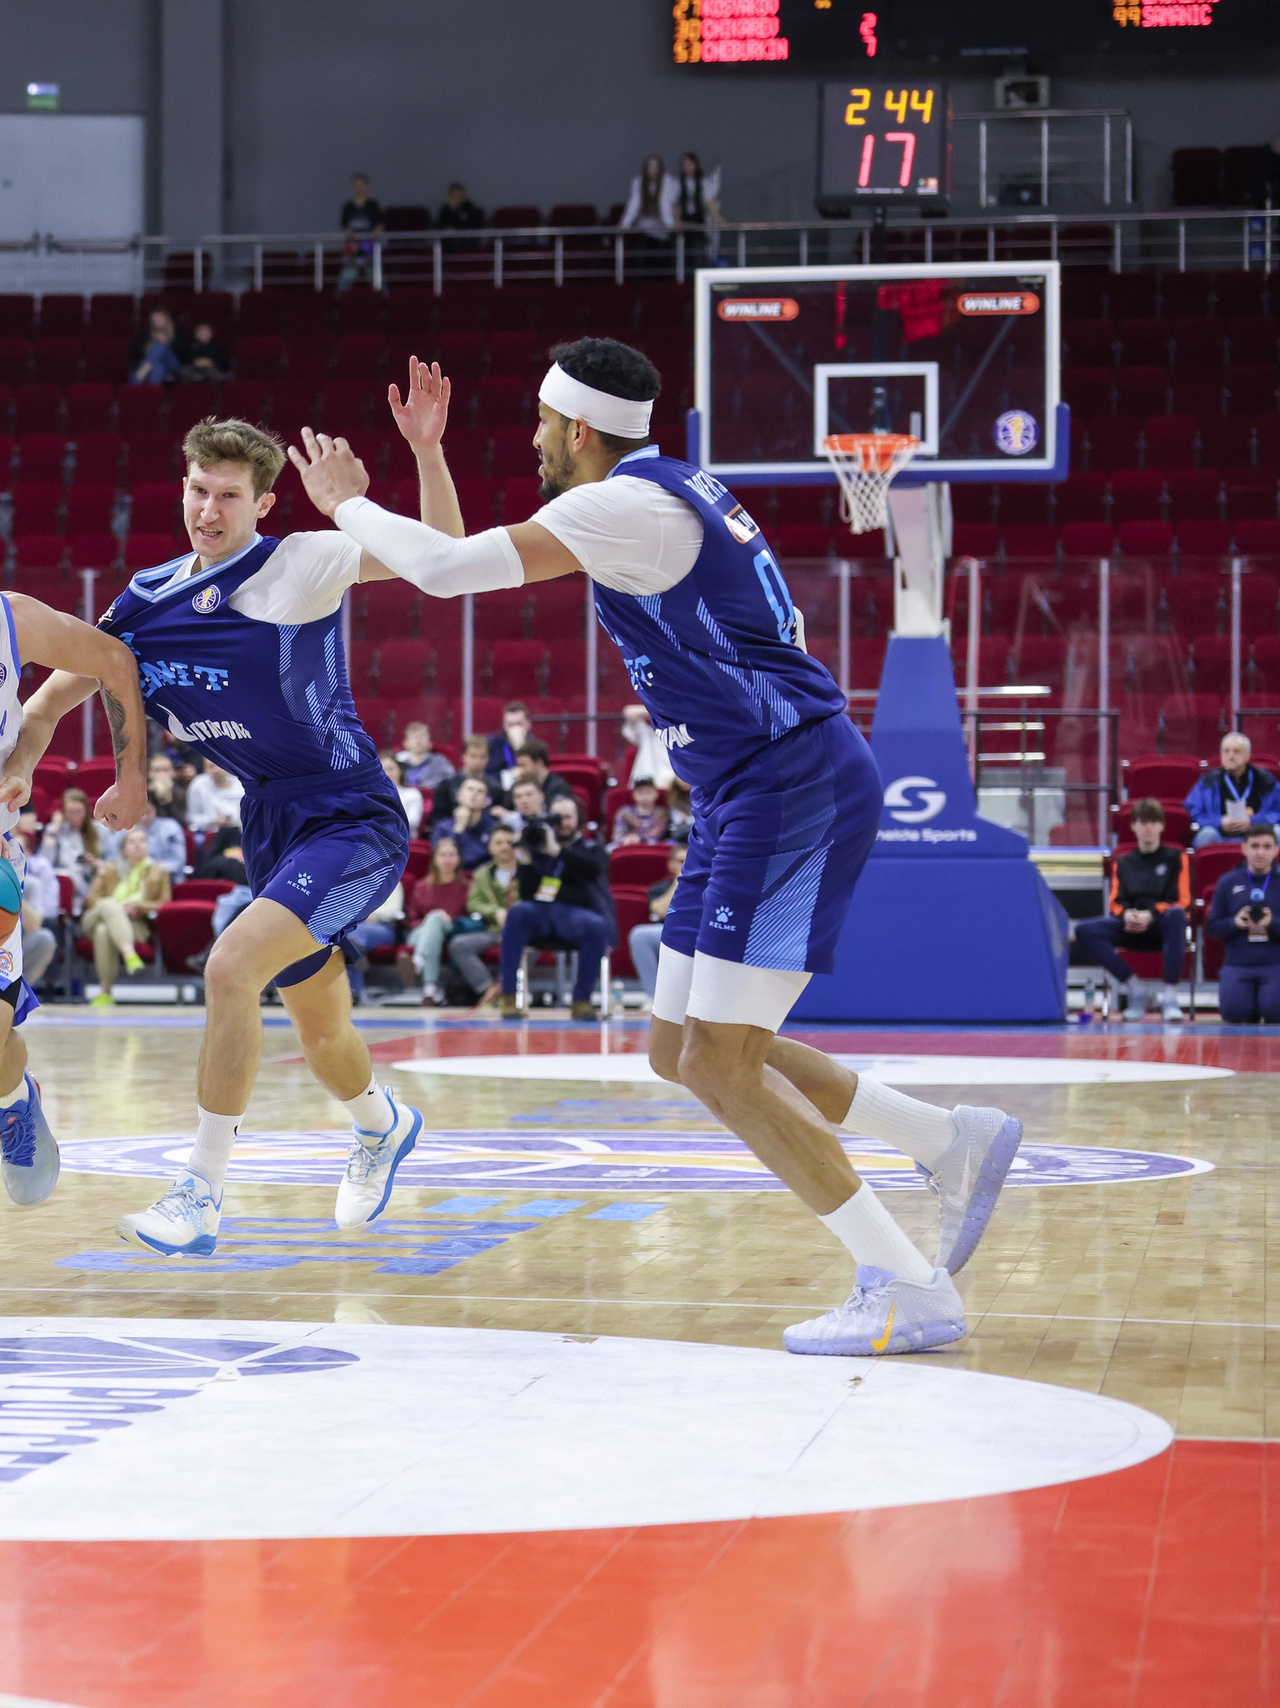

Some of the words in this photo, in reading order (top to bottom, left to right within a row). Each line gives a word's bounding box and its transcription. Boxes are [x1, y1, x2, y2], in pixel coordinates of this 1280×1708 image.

[1113, 6, 1140, 28] 99
[845, 88, 871, 125] 2
[884, 89, 934, 124] 44
[858, 132, 917, 187] 17
[724, 303, 782, 317] WINLINE
[963, 297, 1022, 311] WINLINE
[921, 828, 977, 844] Sports
[286, 880, 311, 897] KELME
[709, 920, 736, 932] KELME
